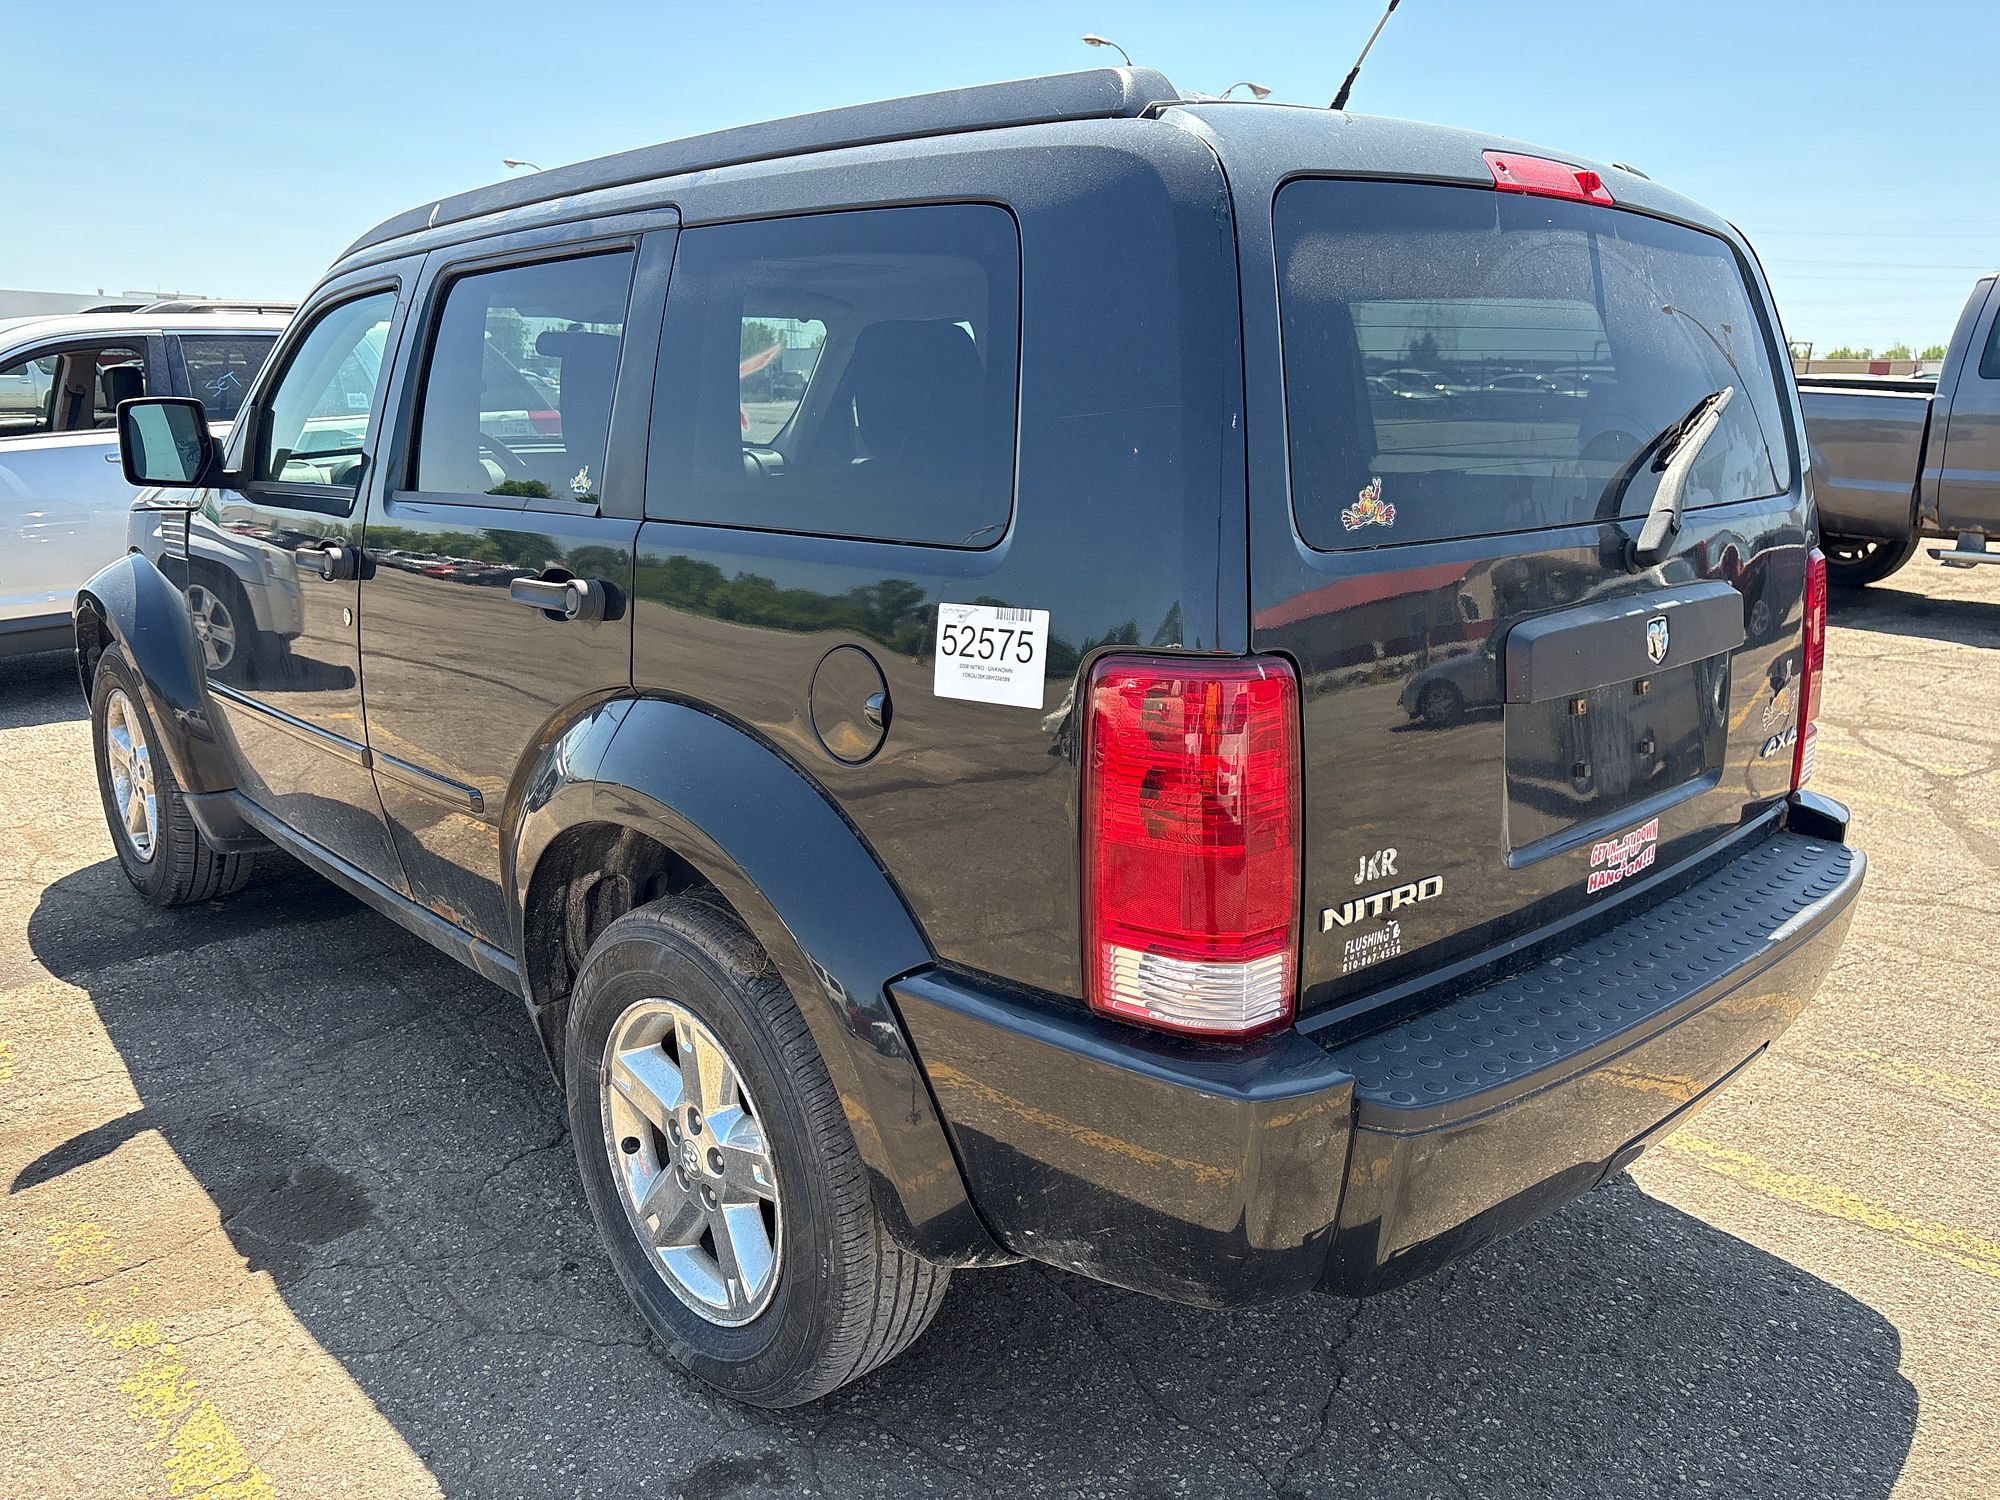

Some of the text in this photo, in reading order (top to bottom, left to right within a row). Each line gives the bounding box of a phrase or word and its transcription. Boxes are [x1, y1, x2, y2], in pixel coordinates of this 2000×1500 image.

[205, 371, 242, 397] SET
[942, 624, 1033, 663] 52575
[988, 666, 1013, 674] UNKNOWN
[1760, 725, 1797, 757] 4X4
[1590, 843, 1607, 868] GET
[1636, 817, 1659, 843] DOWN
[1608, 842, 1641, 867] SHUT UP
[1354, 848, 1398, 885] JKR
[1587, 843, 1656, 894] HANG ON!!!
[1321, 875, 1443, 933] NITRO
[1342, 945, 1401, 973] 810-867-4558
[1343, 939, 1401, 962] AUTO PLAZA
